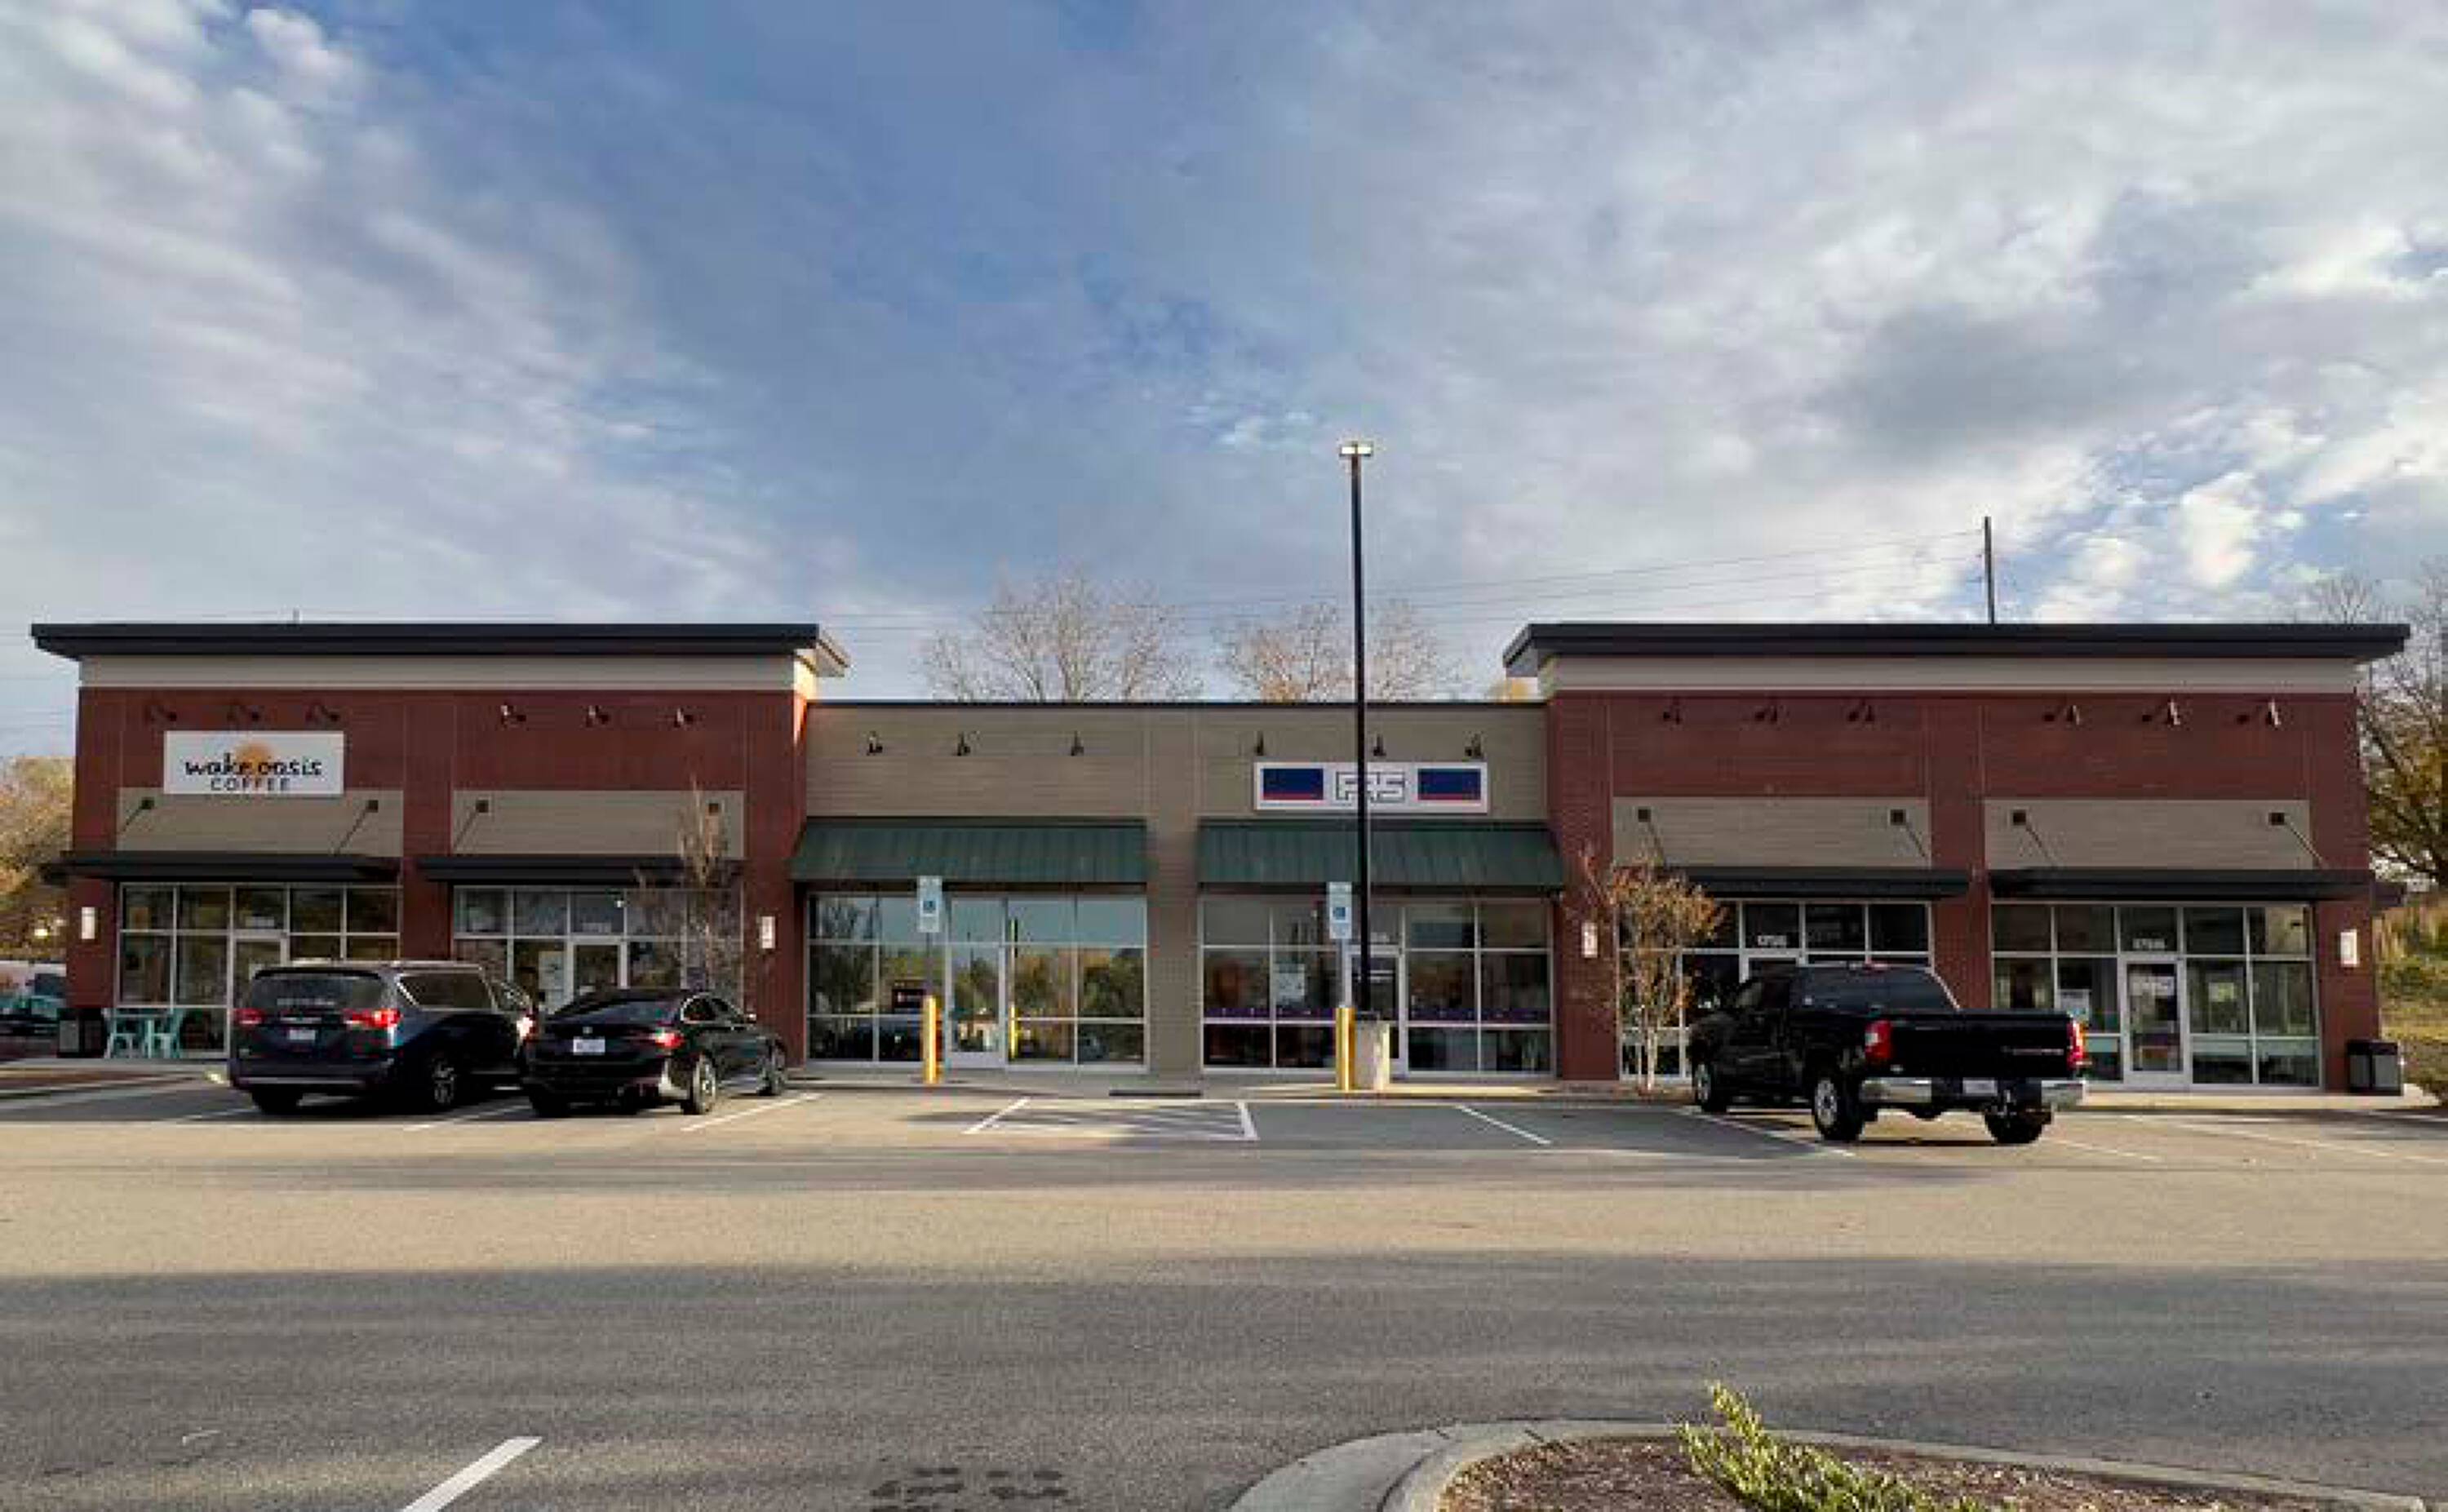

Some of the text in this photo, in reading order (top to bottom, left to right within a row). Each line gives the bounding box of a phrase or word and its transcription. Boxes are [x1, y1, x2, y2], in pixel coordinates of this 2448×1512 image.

[184, 752, 322, 776] wake oasis
[211, 778, 290, 791] COFFEE
